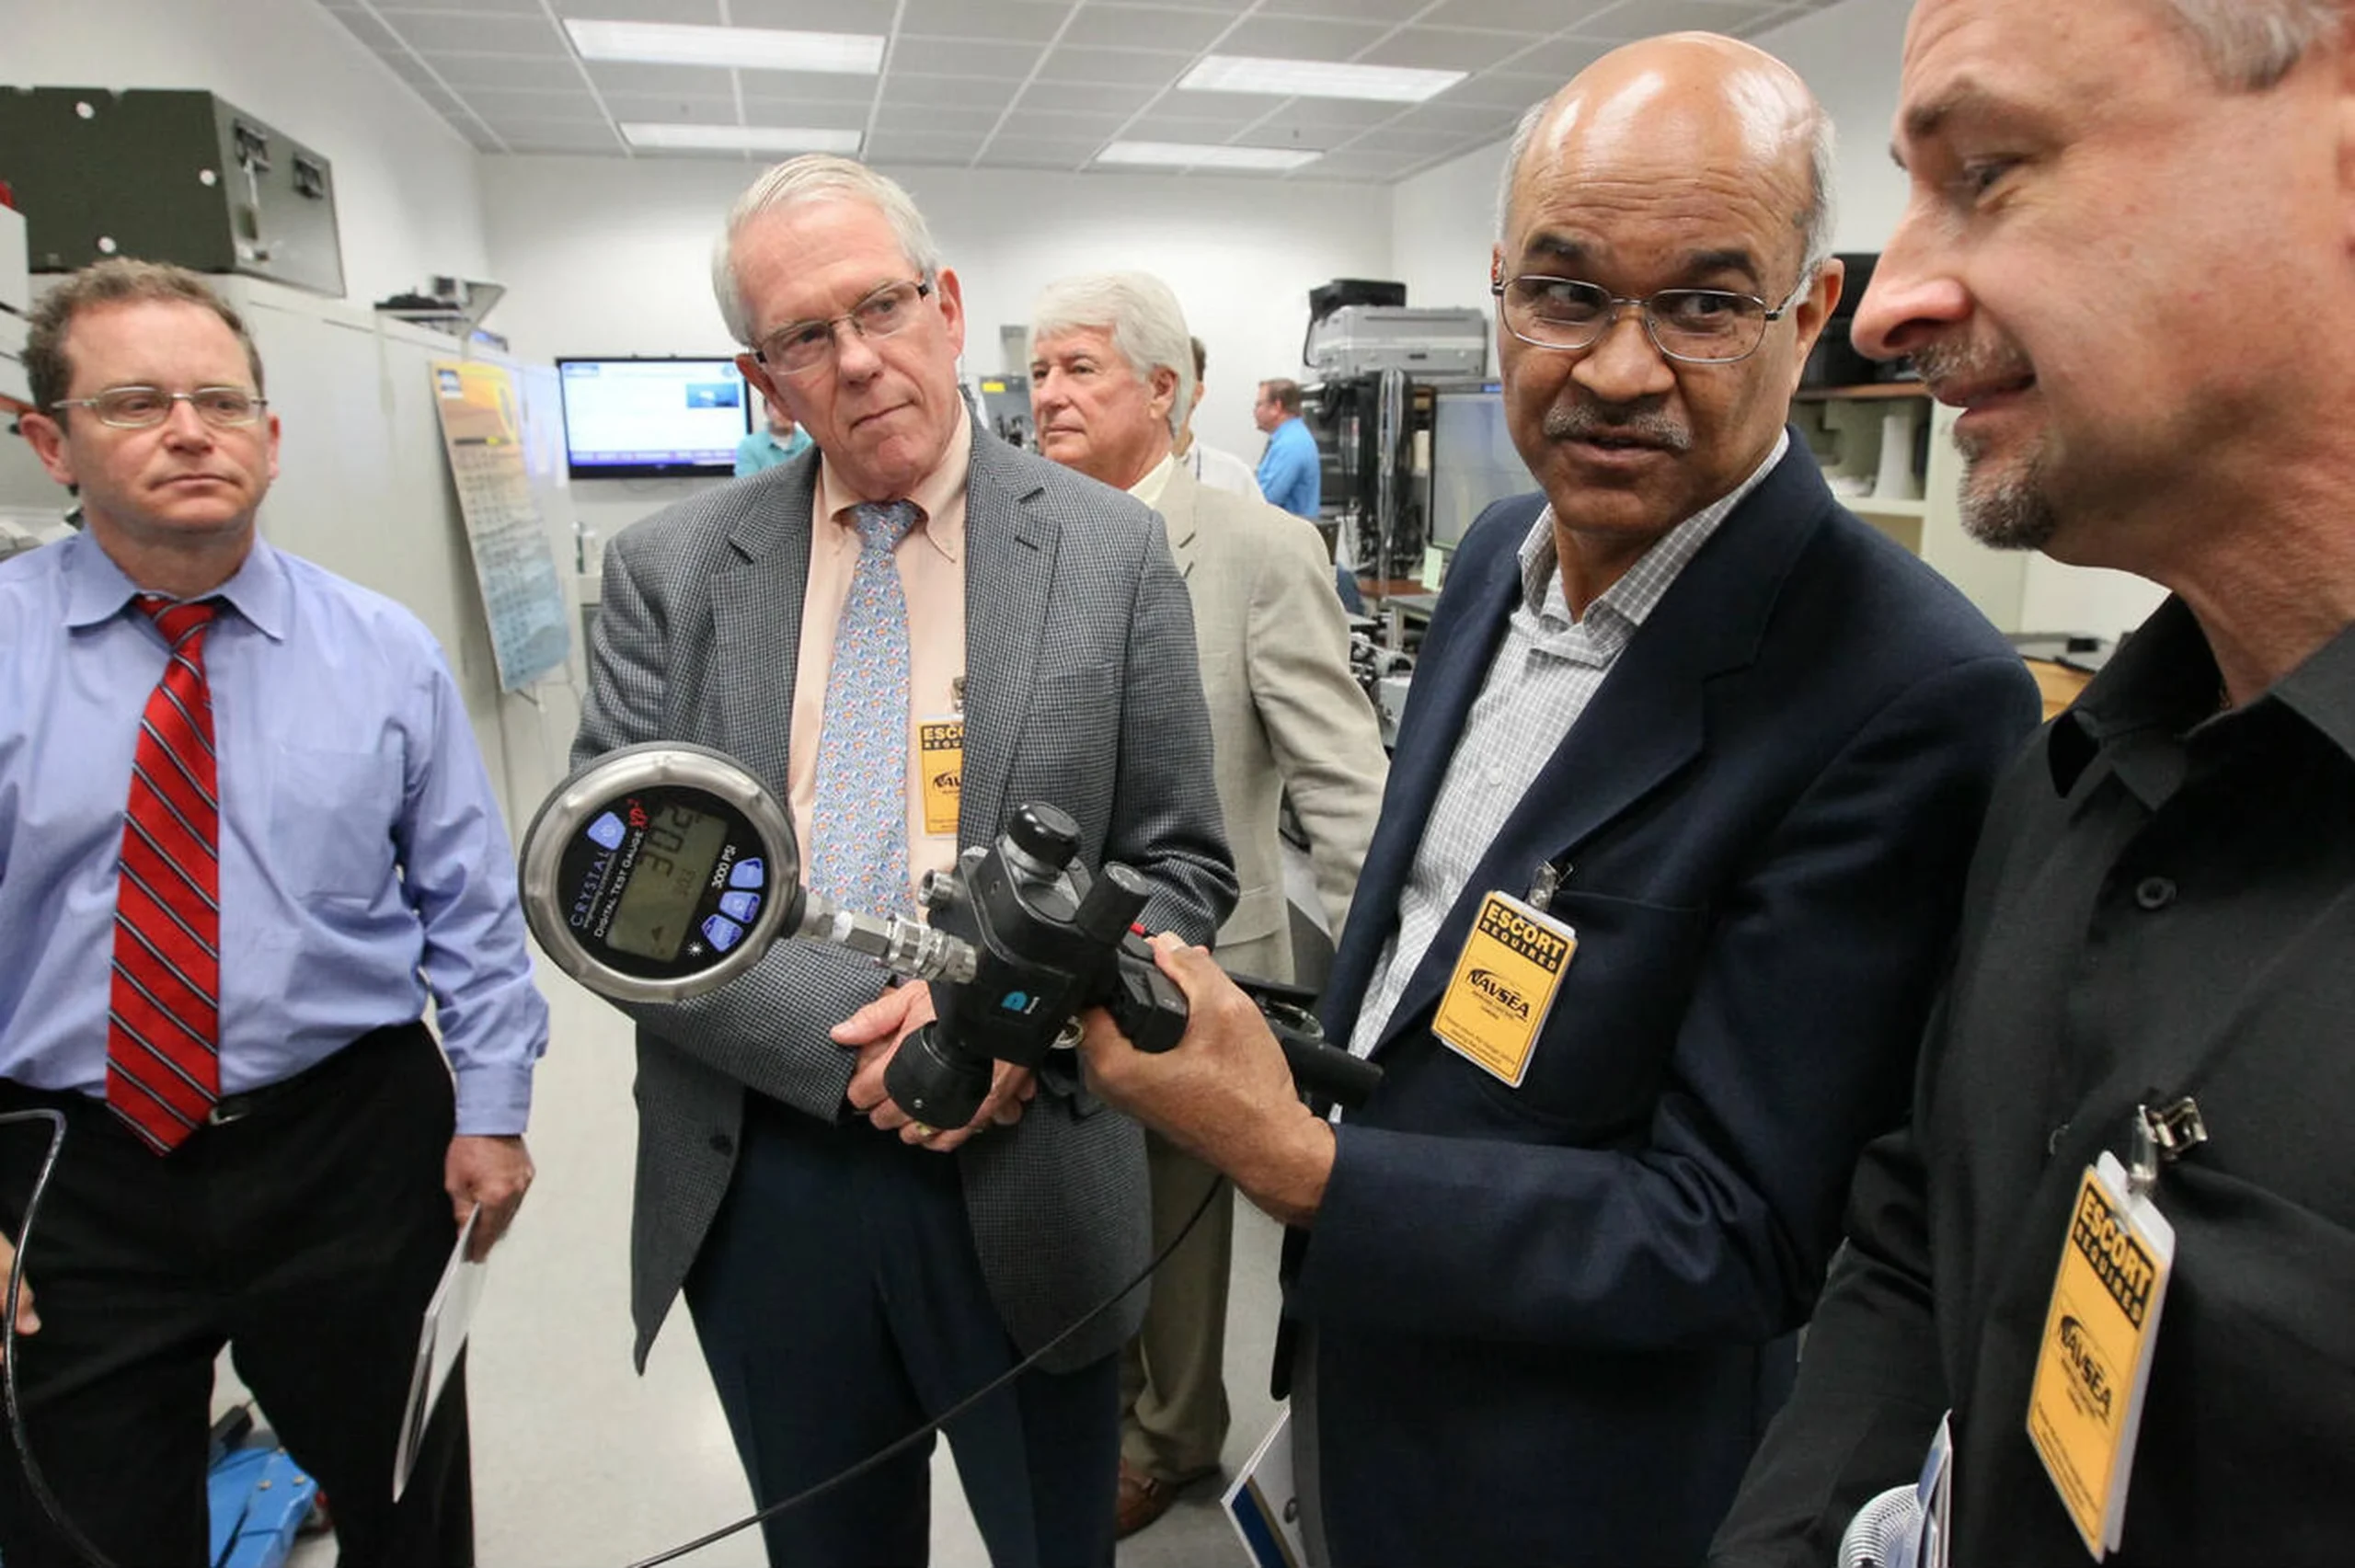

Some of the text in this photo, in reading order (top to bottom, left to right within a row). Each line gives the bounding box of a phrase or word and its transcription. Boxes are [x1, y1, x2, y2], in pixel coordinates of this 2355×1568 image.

[570, 851, 610, 927] CRYSTAL
[593, 897, 617, 937] DIGITAL
[611, 868, 627, 896] TEST
[621, 830, 643, 868] GAUGE
[711, 844, 737, 888] 3000 PSI
[1479, 921, 1557, 971] REQUIRED
[1486, 904, 1565, 959] ESCORT
[1469, 968, 1531, 1019] NAVSEA
[2075, 1222, 2142, 1322] REQUIRED
[2081, 1190, 2153, 1297] ESCORT
